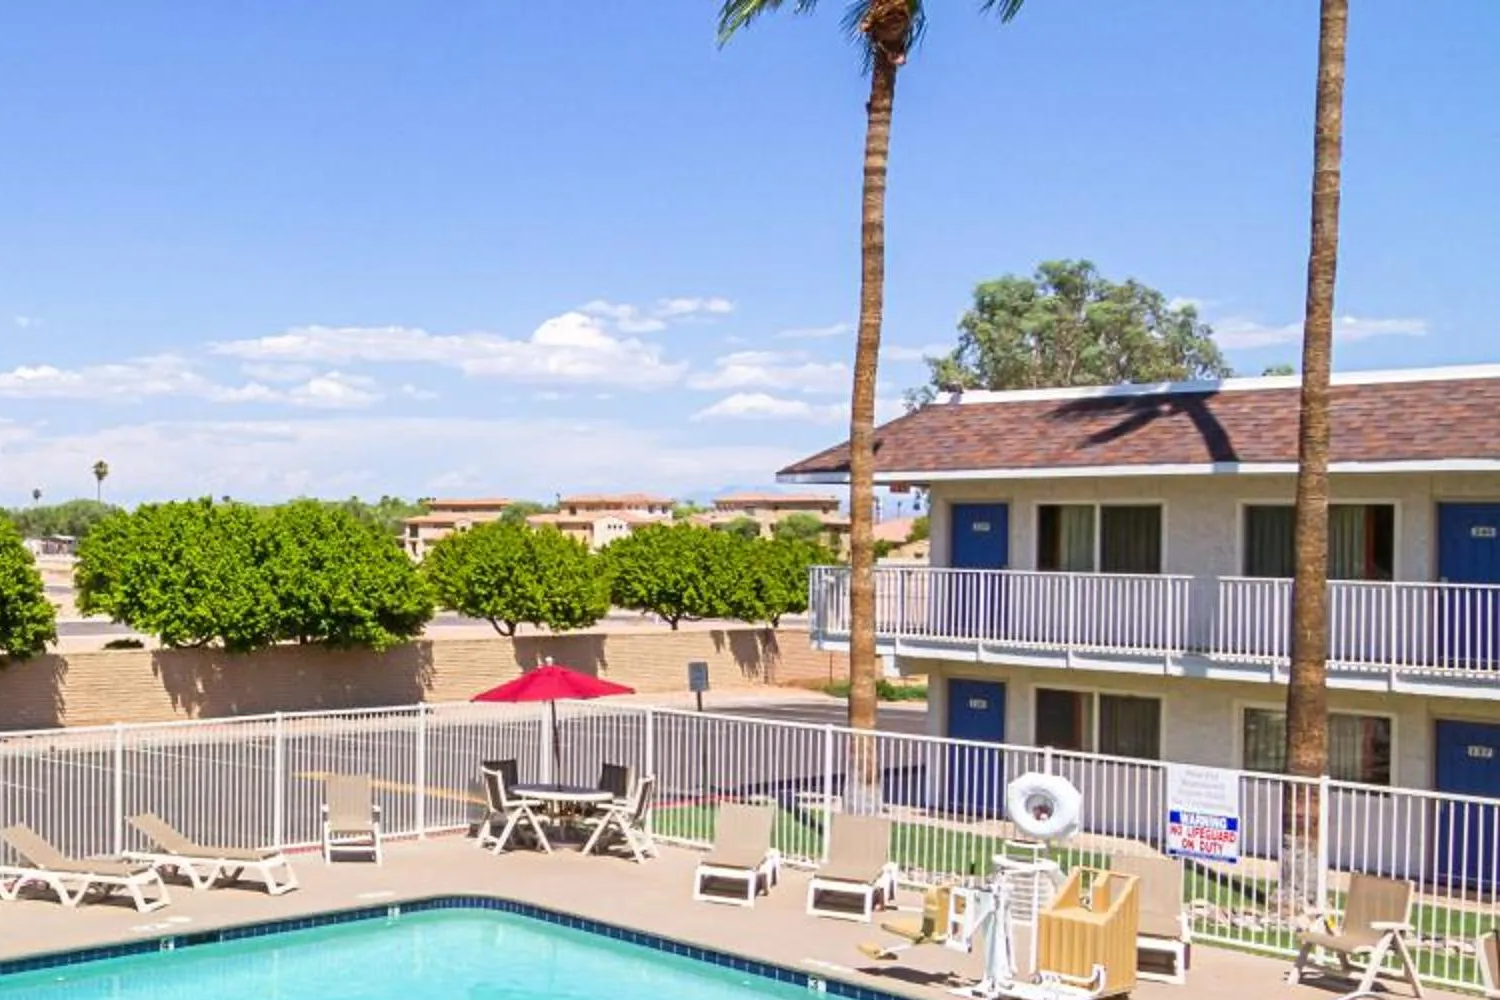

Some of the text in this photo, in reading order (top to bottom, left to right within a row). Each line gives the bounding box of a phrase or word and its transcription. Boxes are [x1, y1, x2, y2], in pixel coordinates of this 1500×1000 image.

[1170, 825, 1236, 843] NO LIFEGUARD
[1181, 838, 1223, 854] ON DUTY
